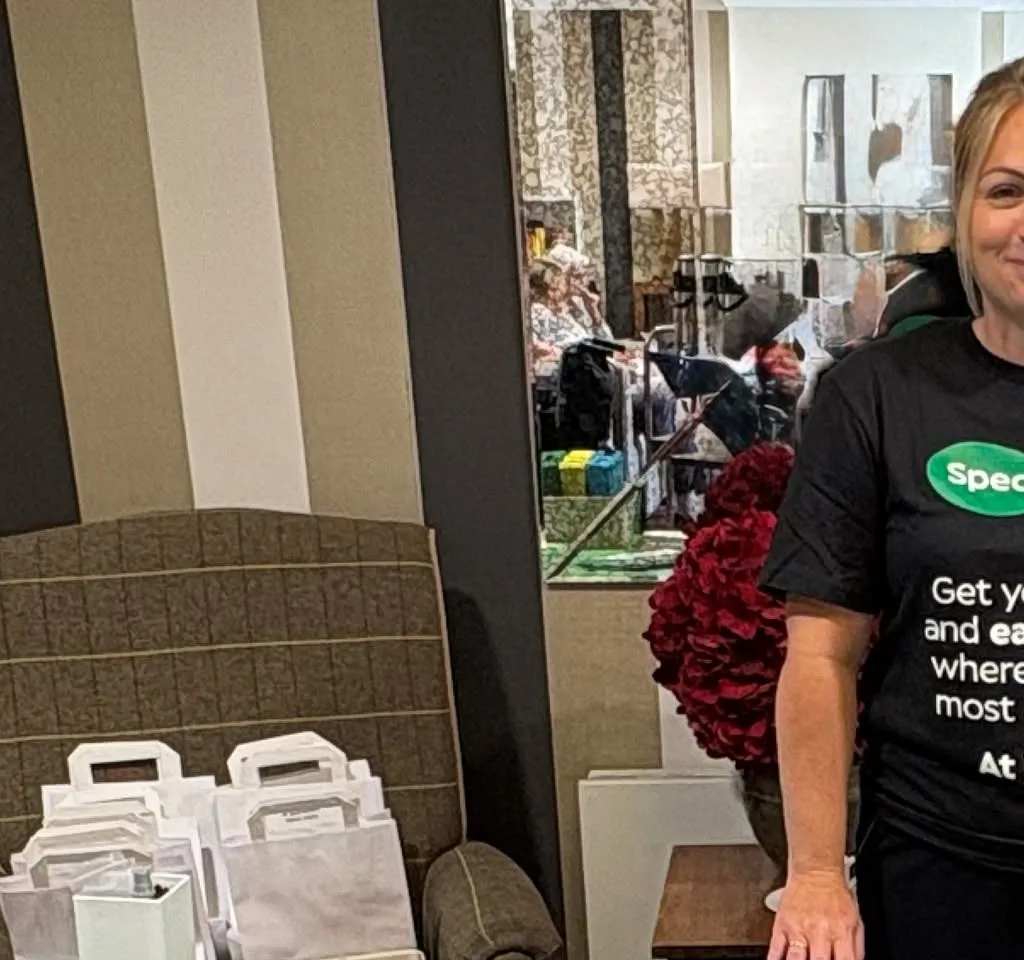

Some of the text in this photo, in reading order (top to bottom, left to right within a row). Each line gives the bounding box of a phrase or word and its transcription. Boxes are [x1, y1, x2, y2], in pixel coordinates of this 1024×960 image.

[932, 576, 992, 607] Get
[924, 615, 979, 644] and
[935, 693, 1016, 723] most
[978, 751, 1016, 779] At
